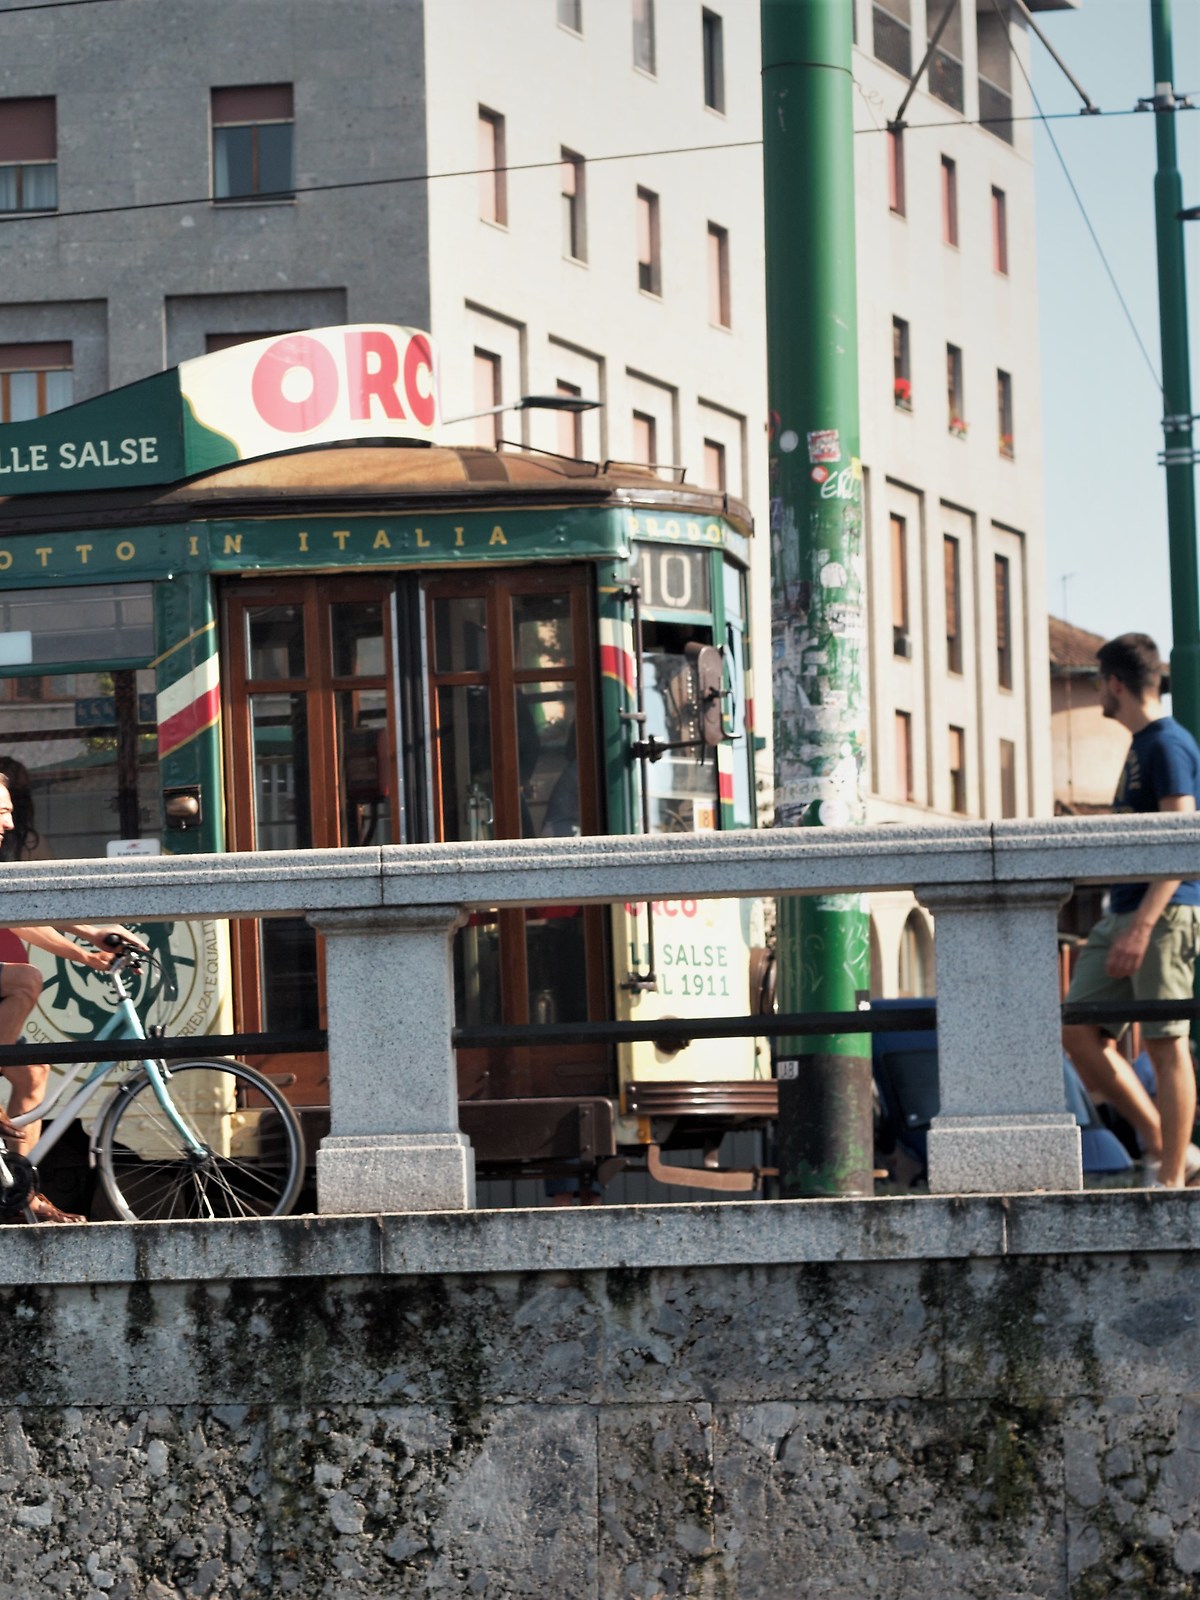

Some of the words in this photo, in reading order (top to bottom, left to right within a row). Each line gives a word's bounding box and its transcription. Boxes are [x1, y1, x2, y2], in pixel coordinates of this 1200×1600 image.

[59, 437, 159, 469] SALSE
[189, 533, 243, 556] IN
[298, 525, 508, 552] ITALIA
[641, 551, 691, 608] 10
[202, 921, 220, 974] QUALIT
[662, 943, 728, 967] SALSE
[681, 974, 730, 996] 1911
